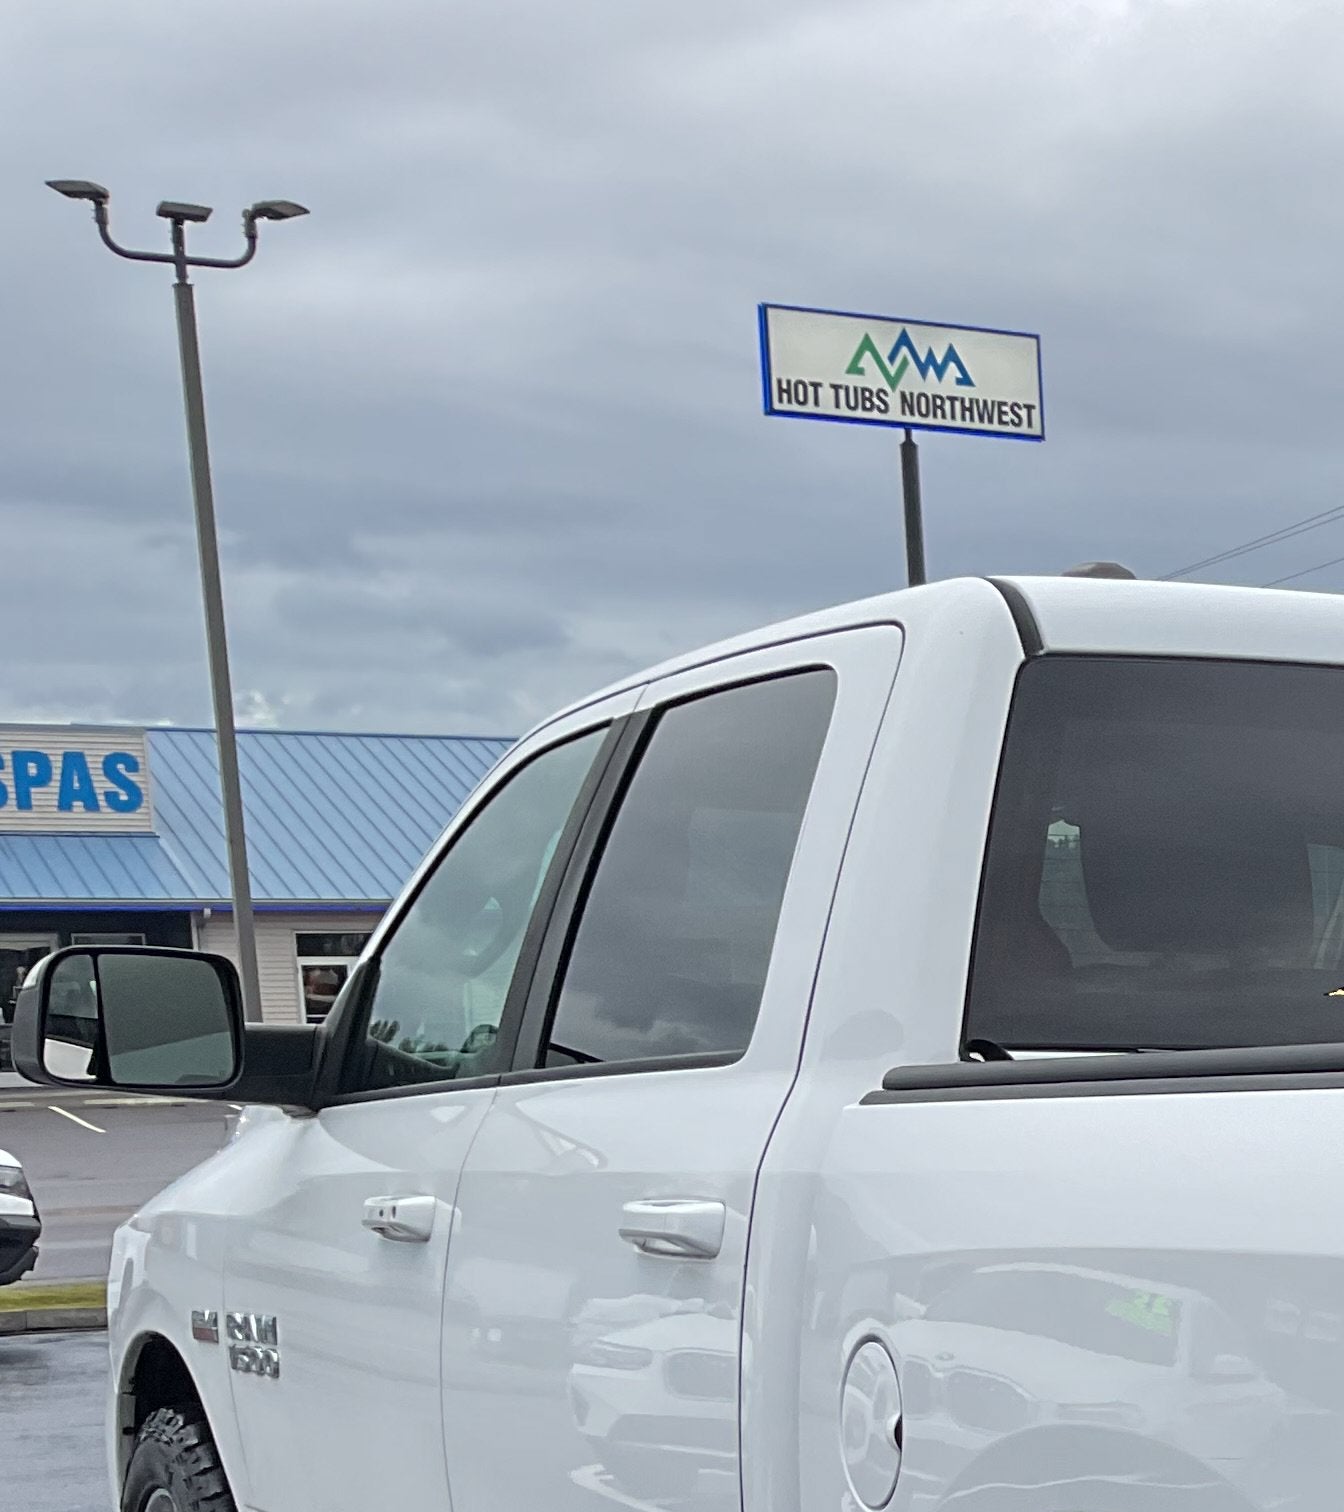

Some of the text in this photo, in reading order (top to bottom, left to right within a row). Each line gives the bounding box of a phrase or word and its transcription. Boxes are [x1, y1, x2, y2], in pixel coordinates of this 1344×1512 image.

[776, 378, 1036, 429] HOT TUBS NORTHWEST
[0, 750, 144, 813] PAS
